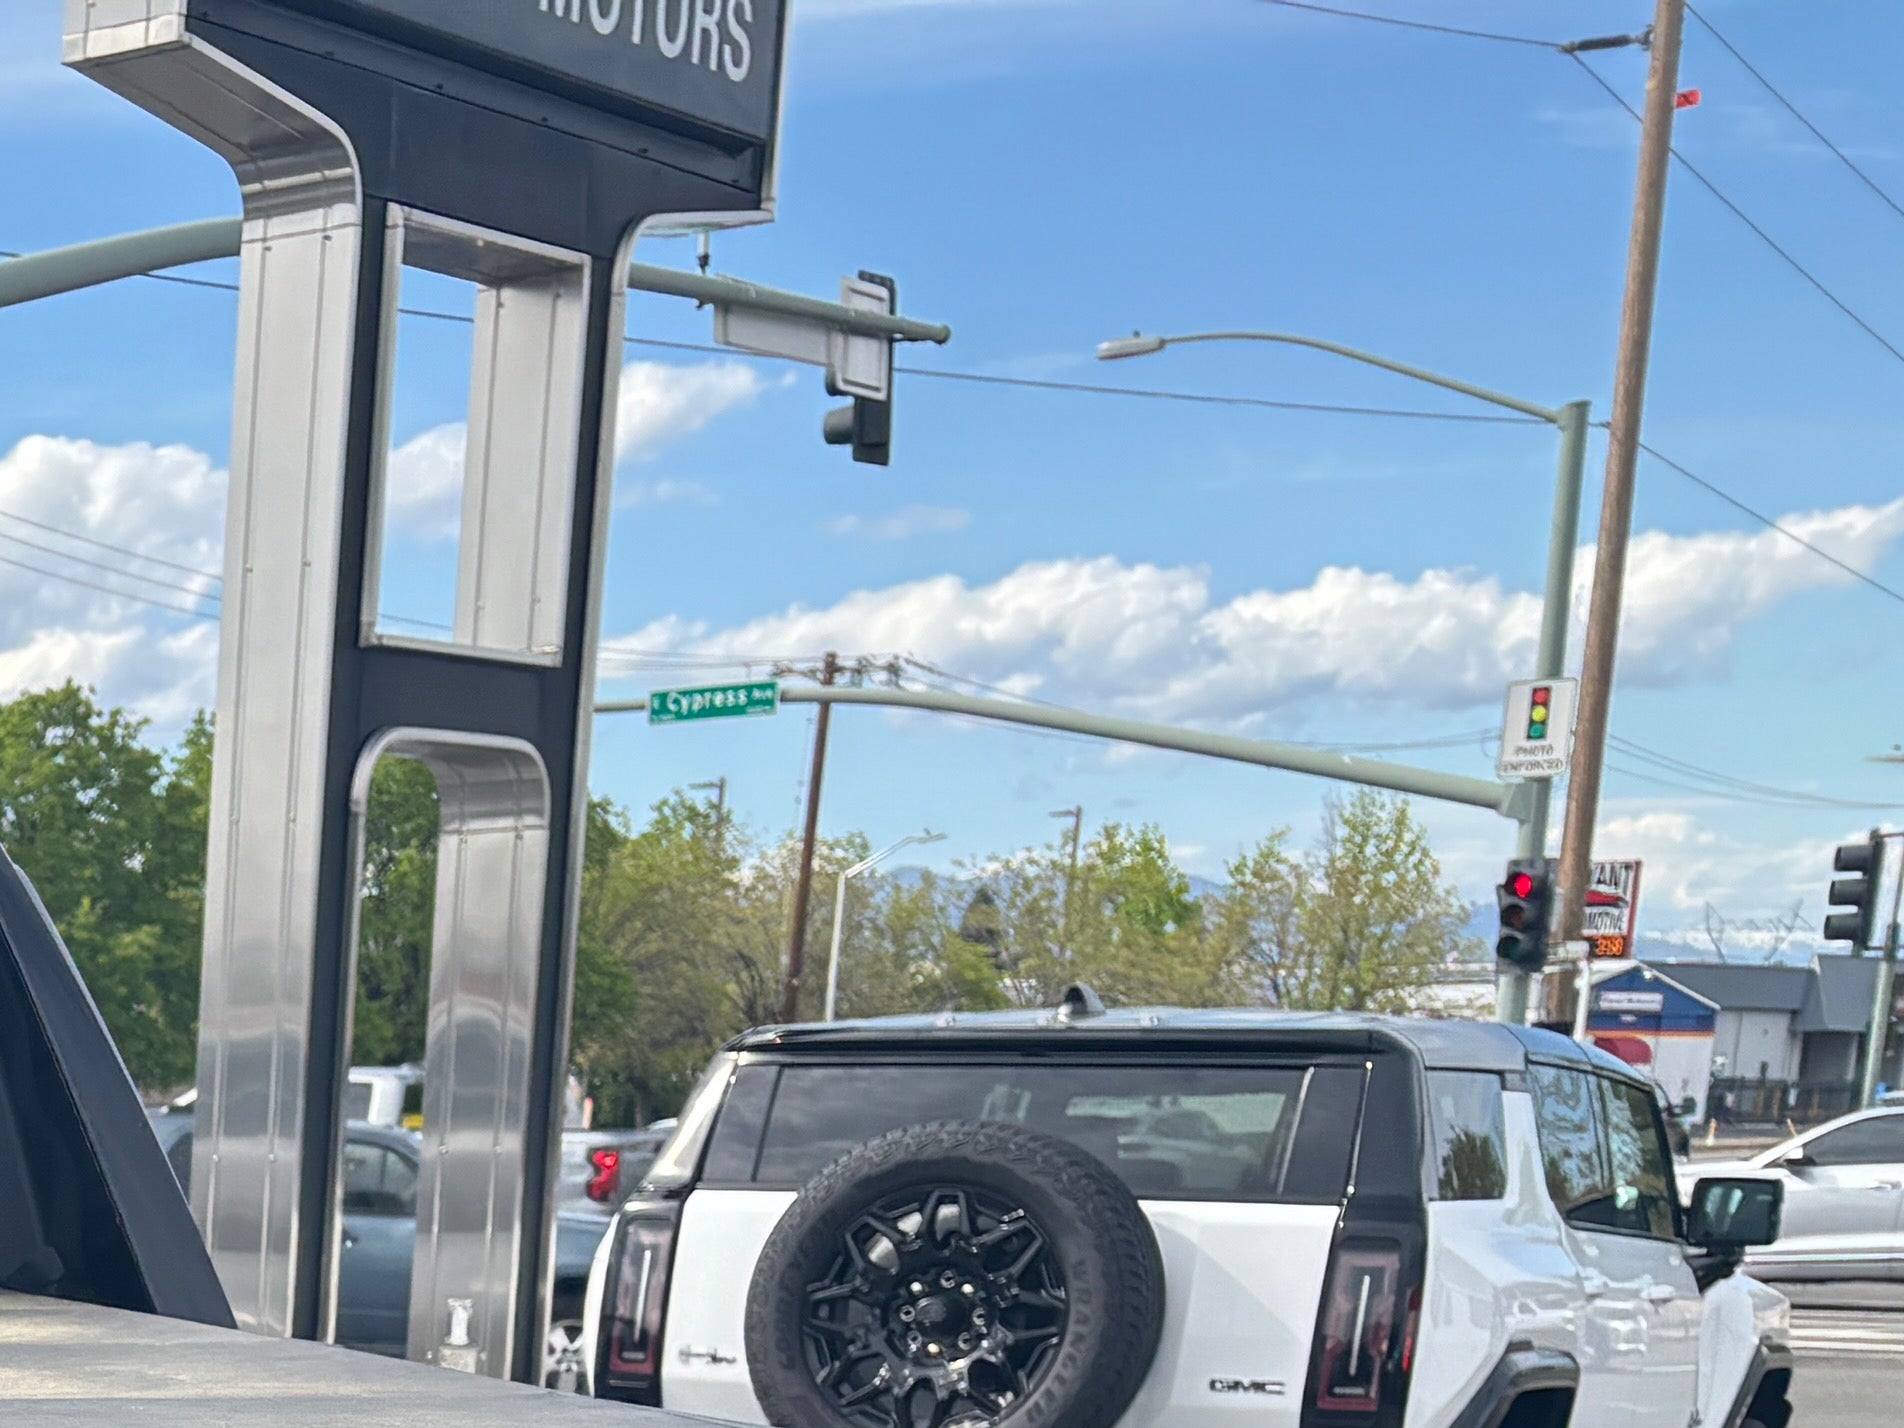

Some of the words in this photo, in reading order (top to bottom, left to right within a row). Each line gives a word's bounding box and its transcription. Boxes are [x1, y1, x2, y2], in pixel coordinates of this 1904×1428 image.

[538, 0, 754, 82] ORS
[666, 688, 748, 716] Cypress
[1209, 1378, 1286, 1396] GMC
